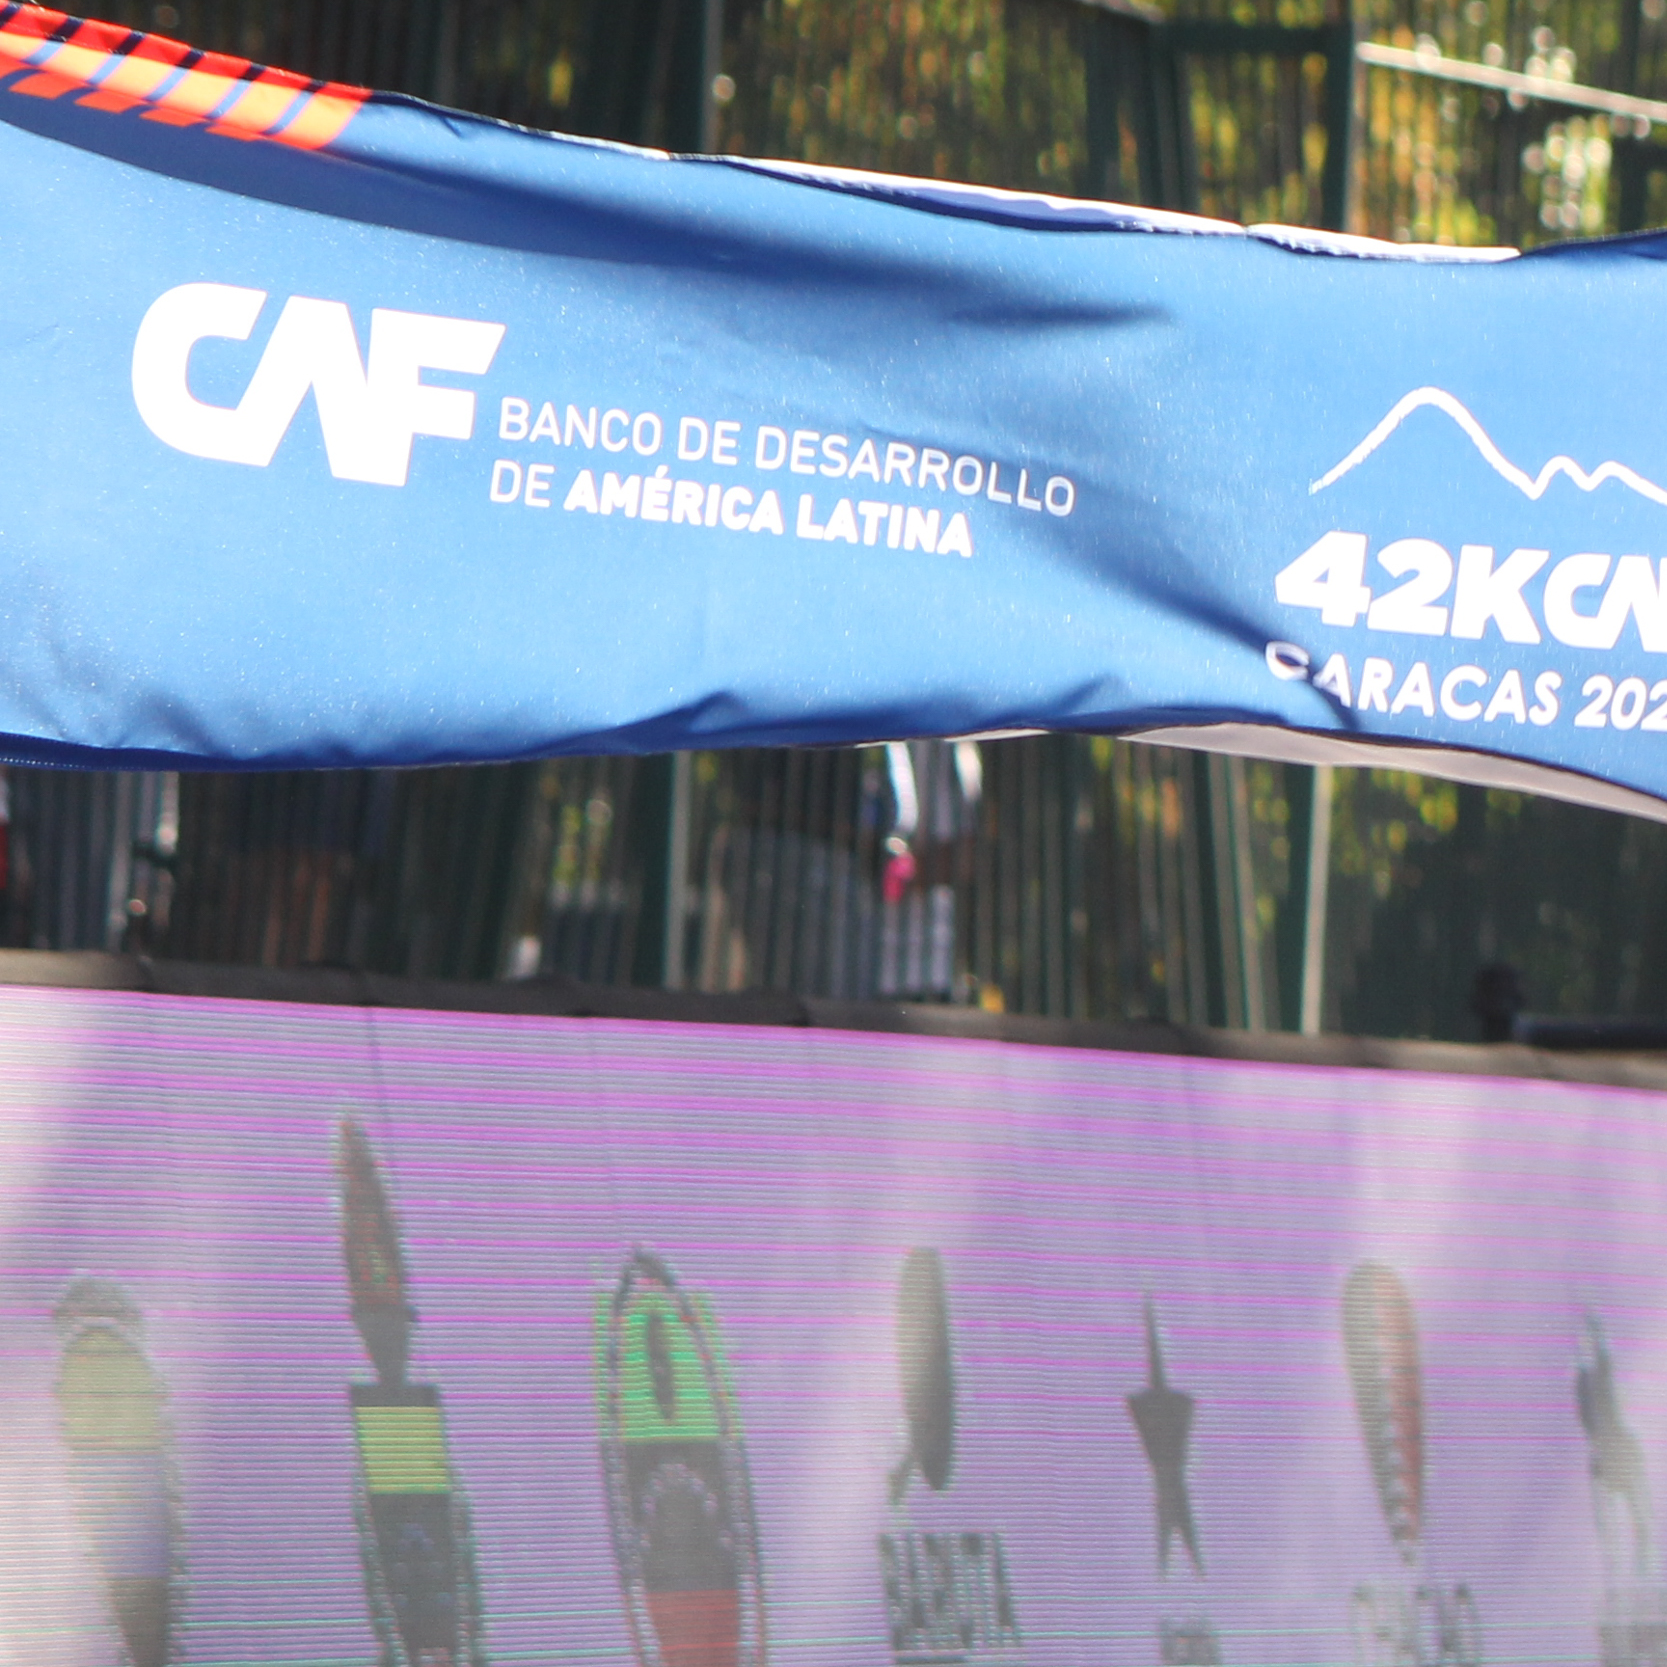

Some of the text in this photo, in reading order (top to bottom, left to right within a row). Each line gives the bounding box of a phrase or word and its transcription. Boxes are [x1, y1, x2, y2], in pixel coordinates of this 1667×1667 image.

[132, 282, 506, 487] CAF
[489, 458, 974, 558] DE AMÉRICA LATINA
[499, 396, 1075, 516] BANCO DE DESARROLLO
[1265, 641, 1562, 726] CARACAS
